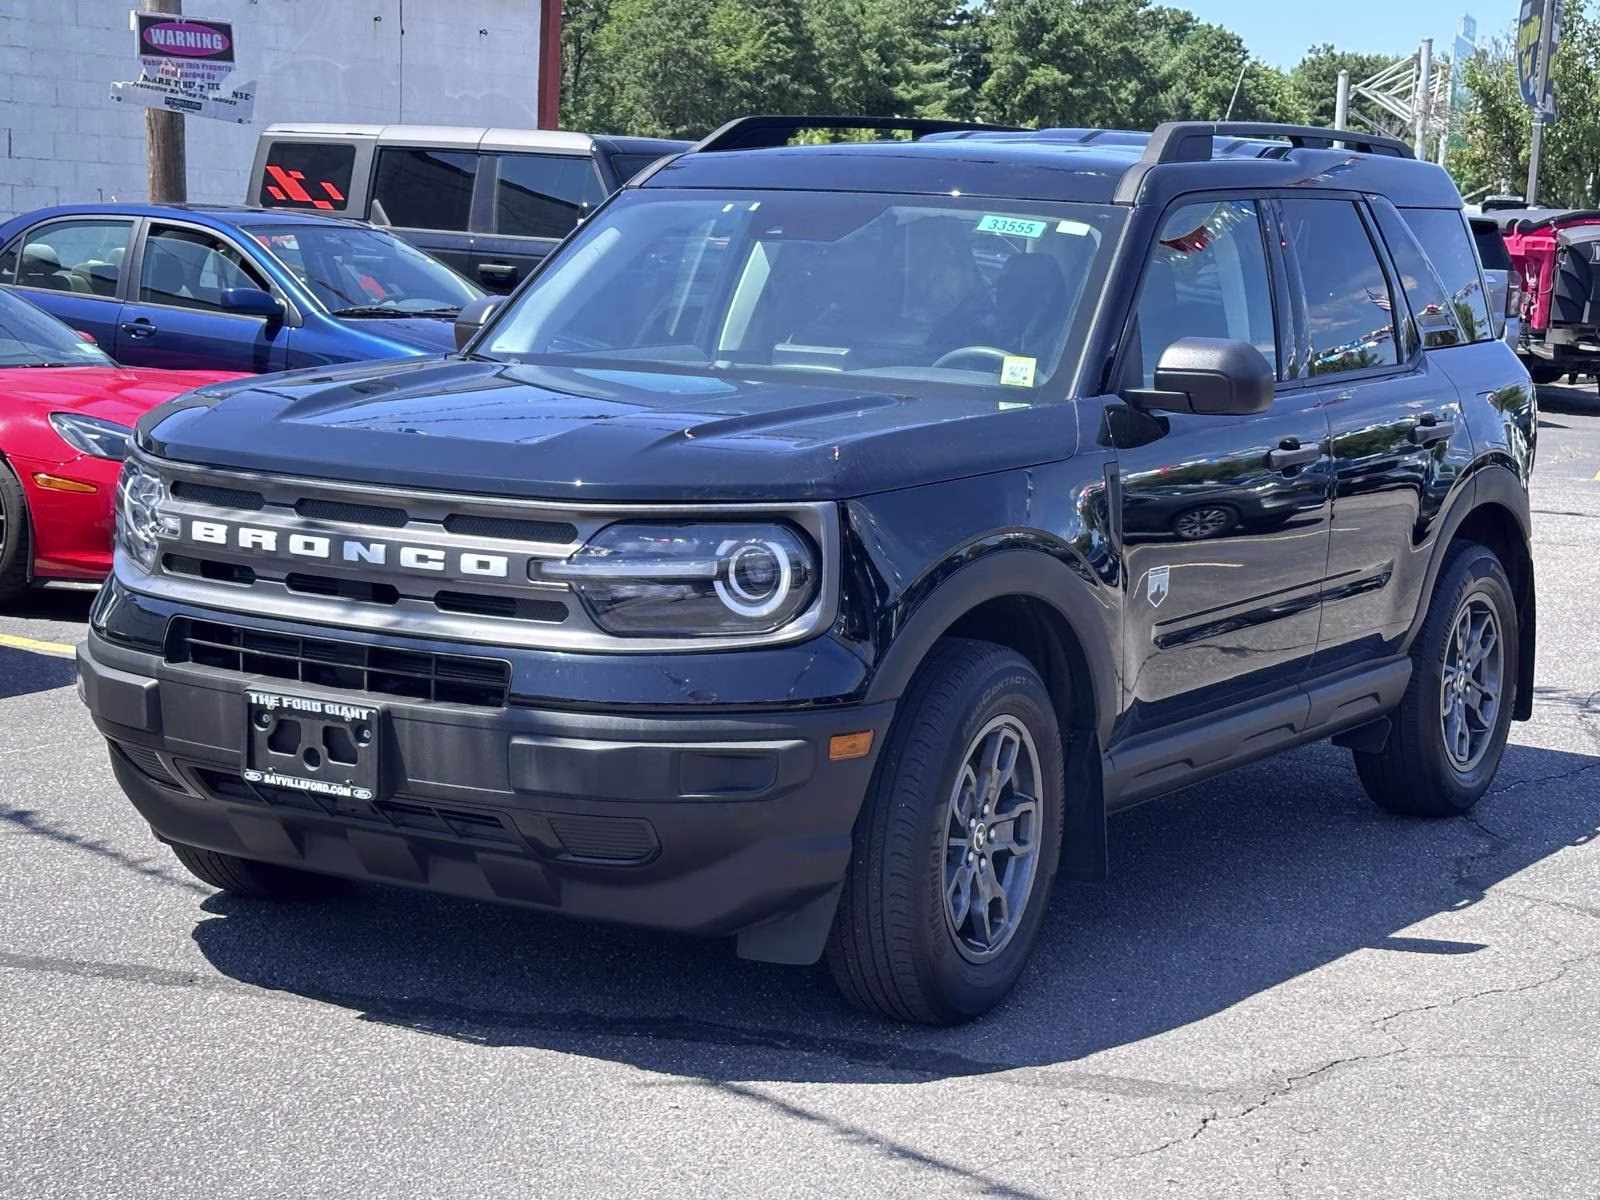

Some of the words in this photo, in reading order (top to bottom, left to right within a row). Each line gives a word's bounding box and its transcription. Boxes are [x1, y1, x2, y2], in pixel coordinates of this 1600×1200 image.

[150, 29, 222, 50] WARNING
[201, 63, 232, 72] Property
[987, 219, 1036, 234] 33555
[191, 520, 508, 577] BRONCO
[250, 693, 280, 708] THE
[283, 697, 322, 713] FORD
[325, 704, 369, 720] GIANT
[264, 774, 352, 796] SAYVILLEFORD.COM
